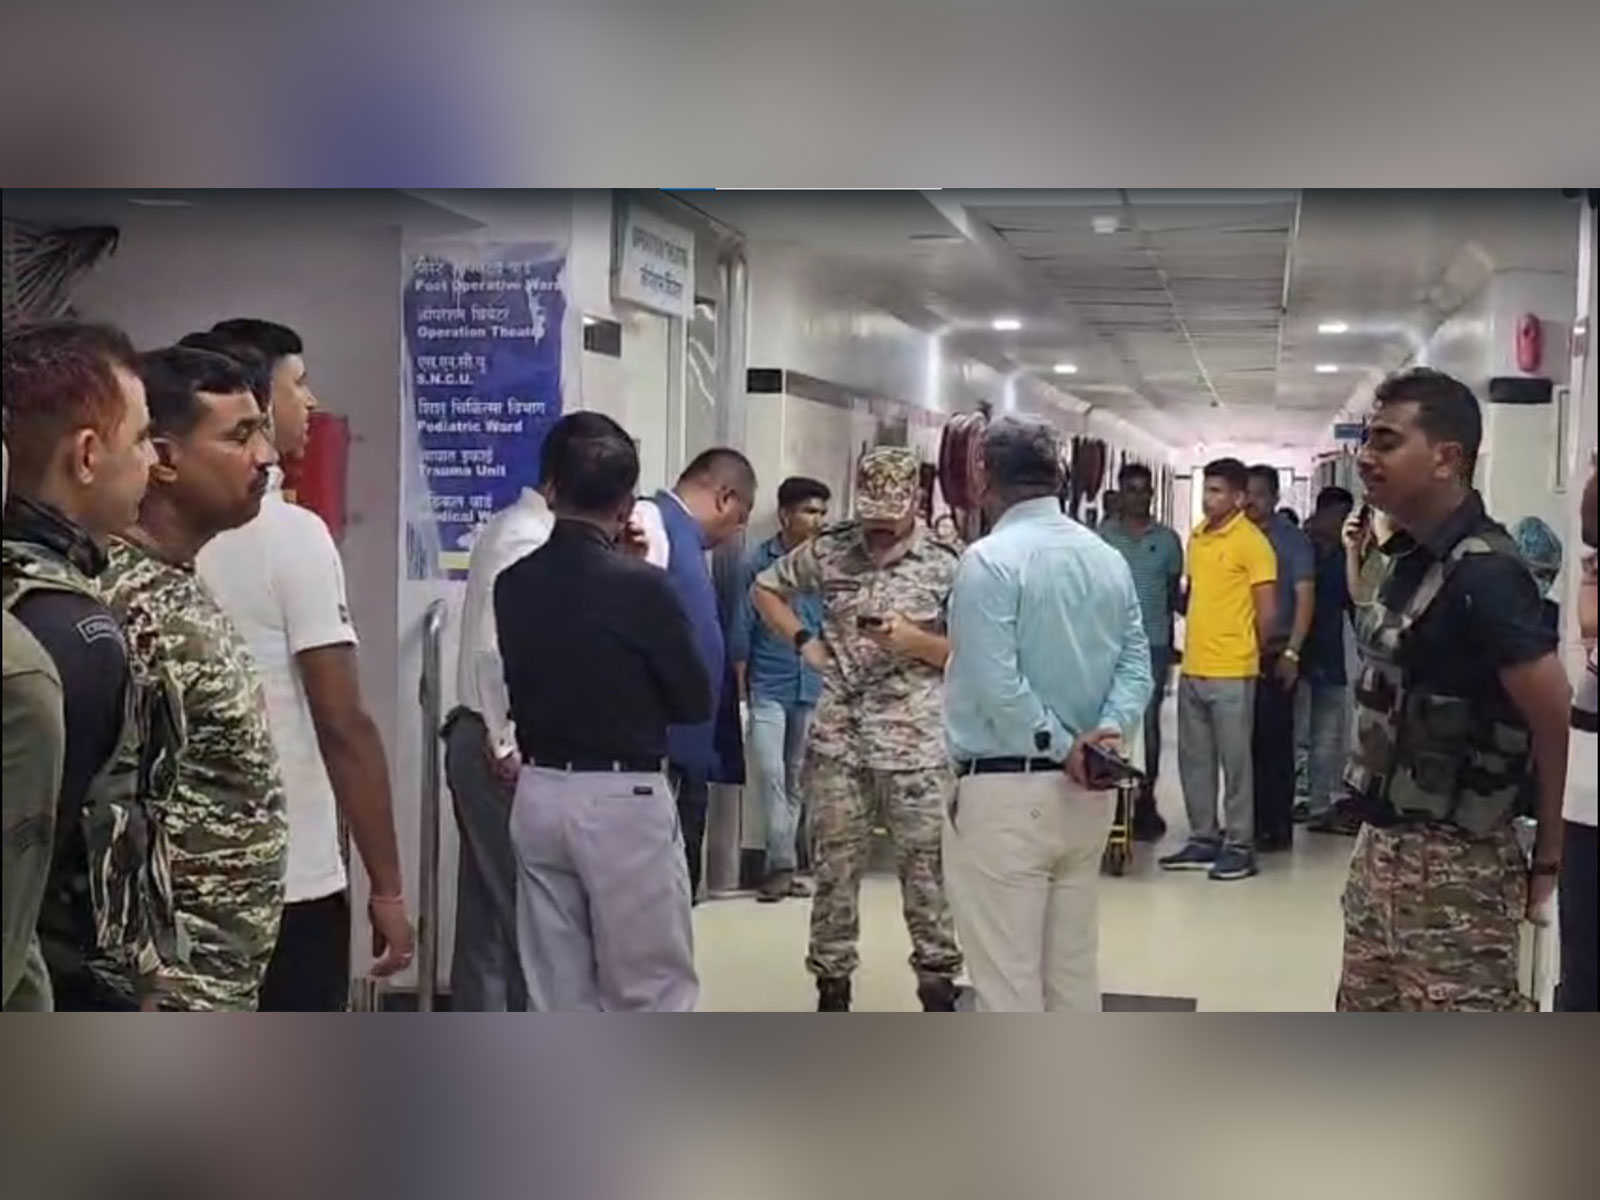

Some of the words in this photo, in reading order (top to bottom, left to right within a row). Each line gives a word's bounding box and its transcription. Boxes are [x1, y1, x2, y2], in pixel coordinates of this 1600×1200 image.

[452, 279, 521, 293] Operative
[417, 326, 486, 339] Operation
[491, 326, 545, 338] Theat
[416, 373, 474, 385] S.N.C.U.
[507, 396, 546, 415] विभाग
[485, 420, 523, 432] Ward
[419, 465, 472, 476] Trauma
[476, 464, 506, 477] Unit
